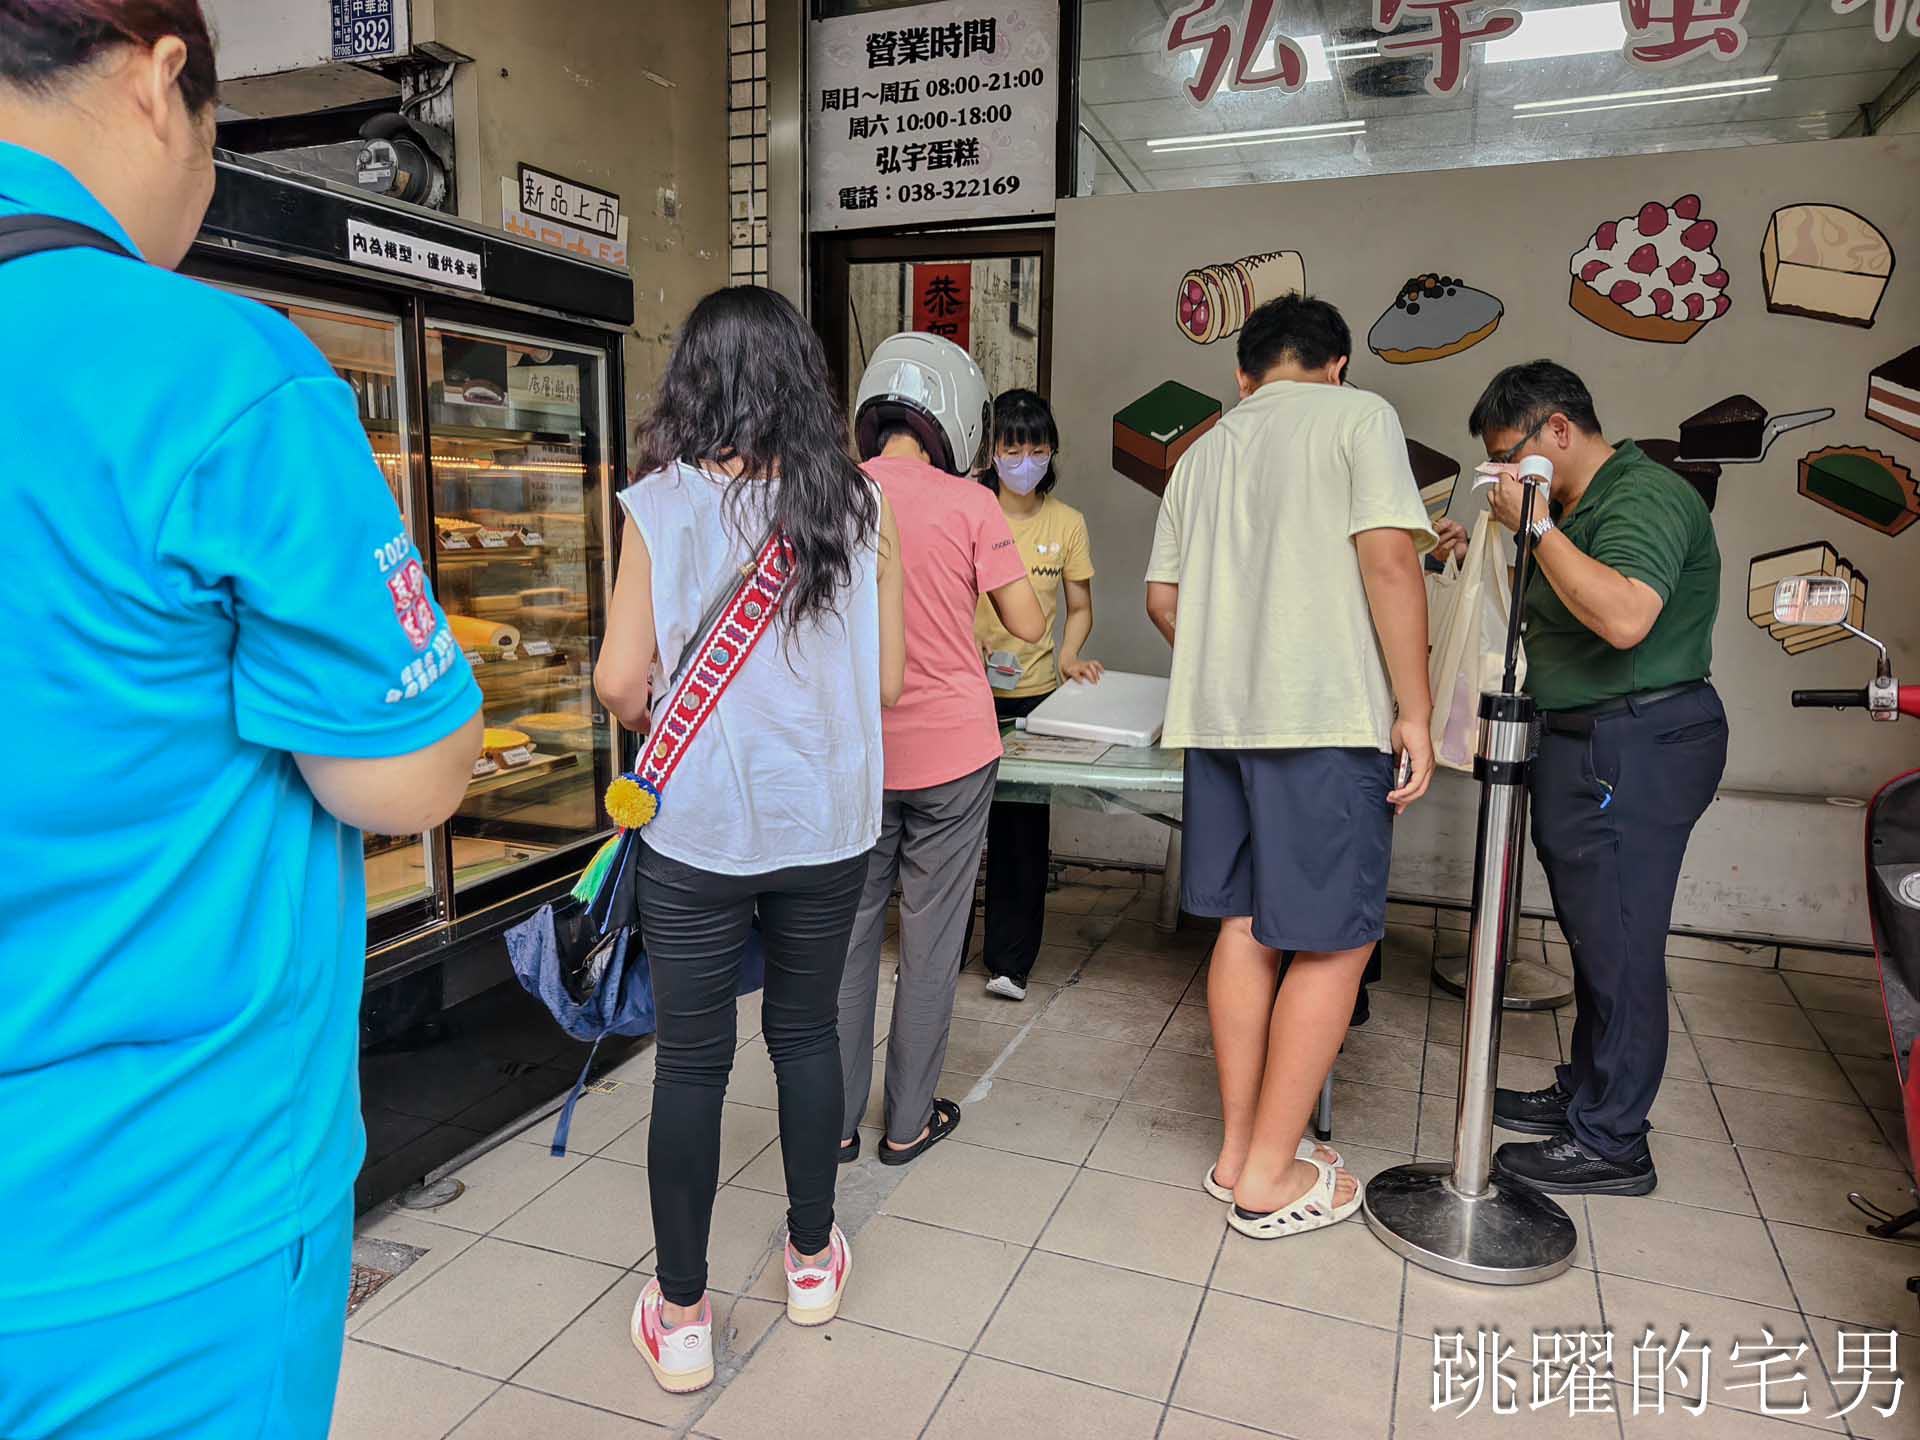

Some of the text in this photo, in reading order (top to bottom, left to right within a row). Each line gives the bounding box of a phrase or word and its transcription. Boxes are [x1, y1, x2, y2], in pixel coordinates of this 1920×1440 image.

[354, 18, 390, 53] 332
[866, 17, 997, 69] 營業時間
[925, 67, 1044, 98] 08:00-21:00
[847, 103, 1012, 140] 周六 10:00-18:00
[875, 137, 980, 175] 弘宇蛋糕
[524, 174, 615, 232] 新品上市
